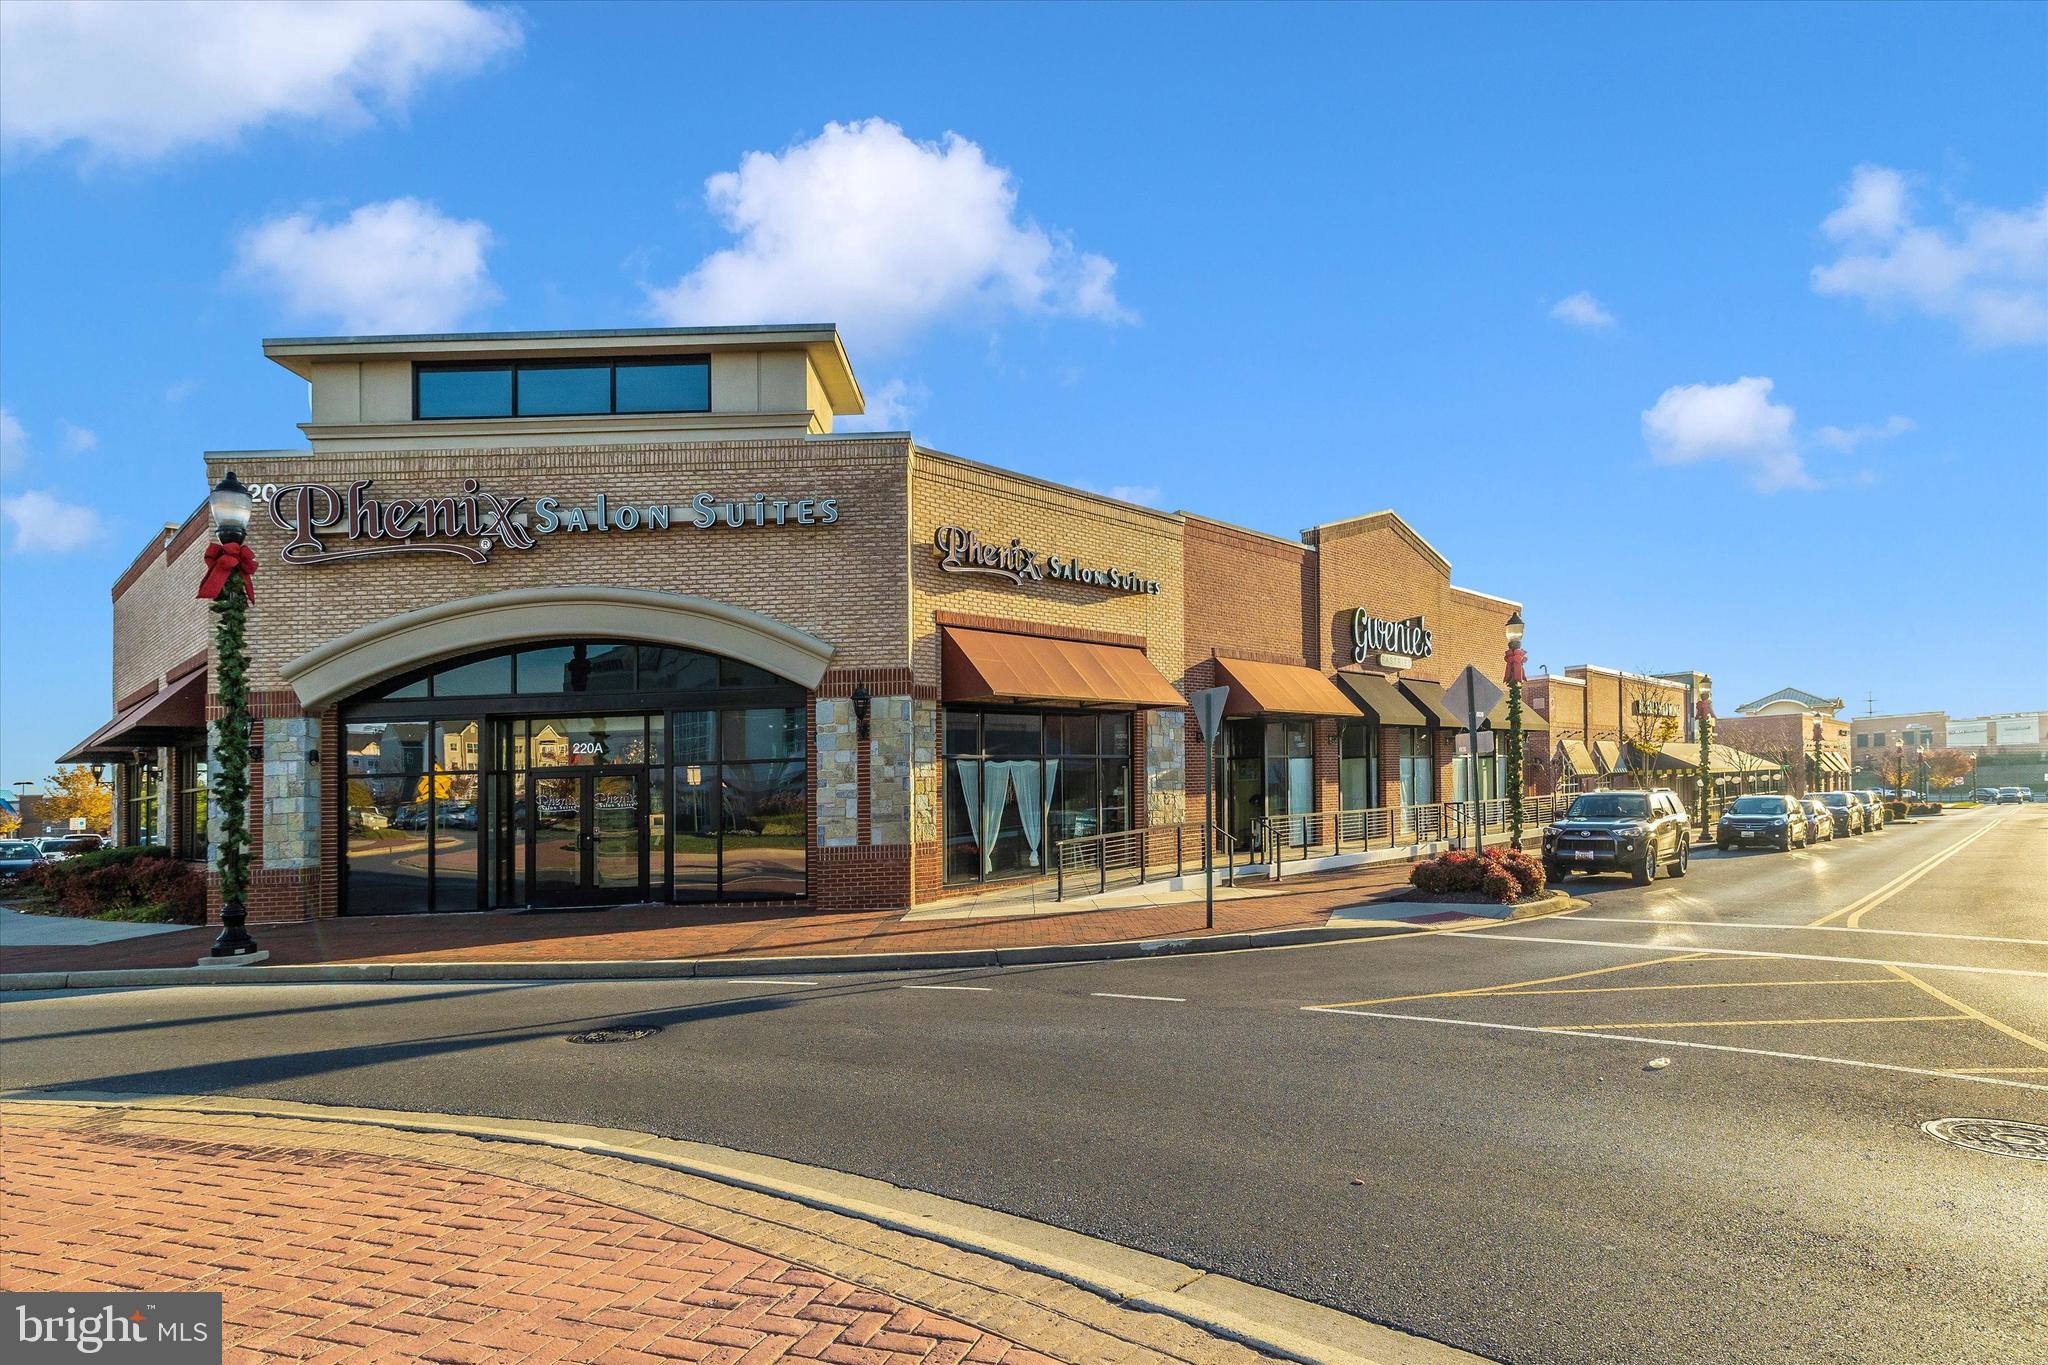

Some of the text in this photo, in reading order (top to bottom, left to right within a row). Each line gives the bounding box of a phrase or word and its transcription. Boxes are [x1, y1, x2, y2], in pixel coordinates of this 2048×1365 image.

[268, 478, 537, 565] Phenix
[935, 524, 1043, 586] Phenix
[1353, 607, 1433, 664] Gwenie's
[572, 742, 603, 754] 220A
[593, 792, 639, 809] Phenix
